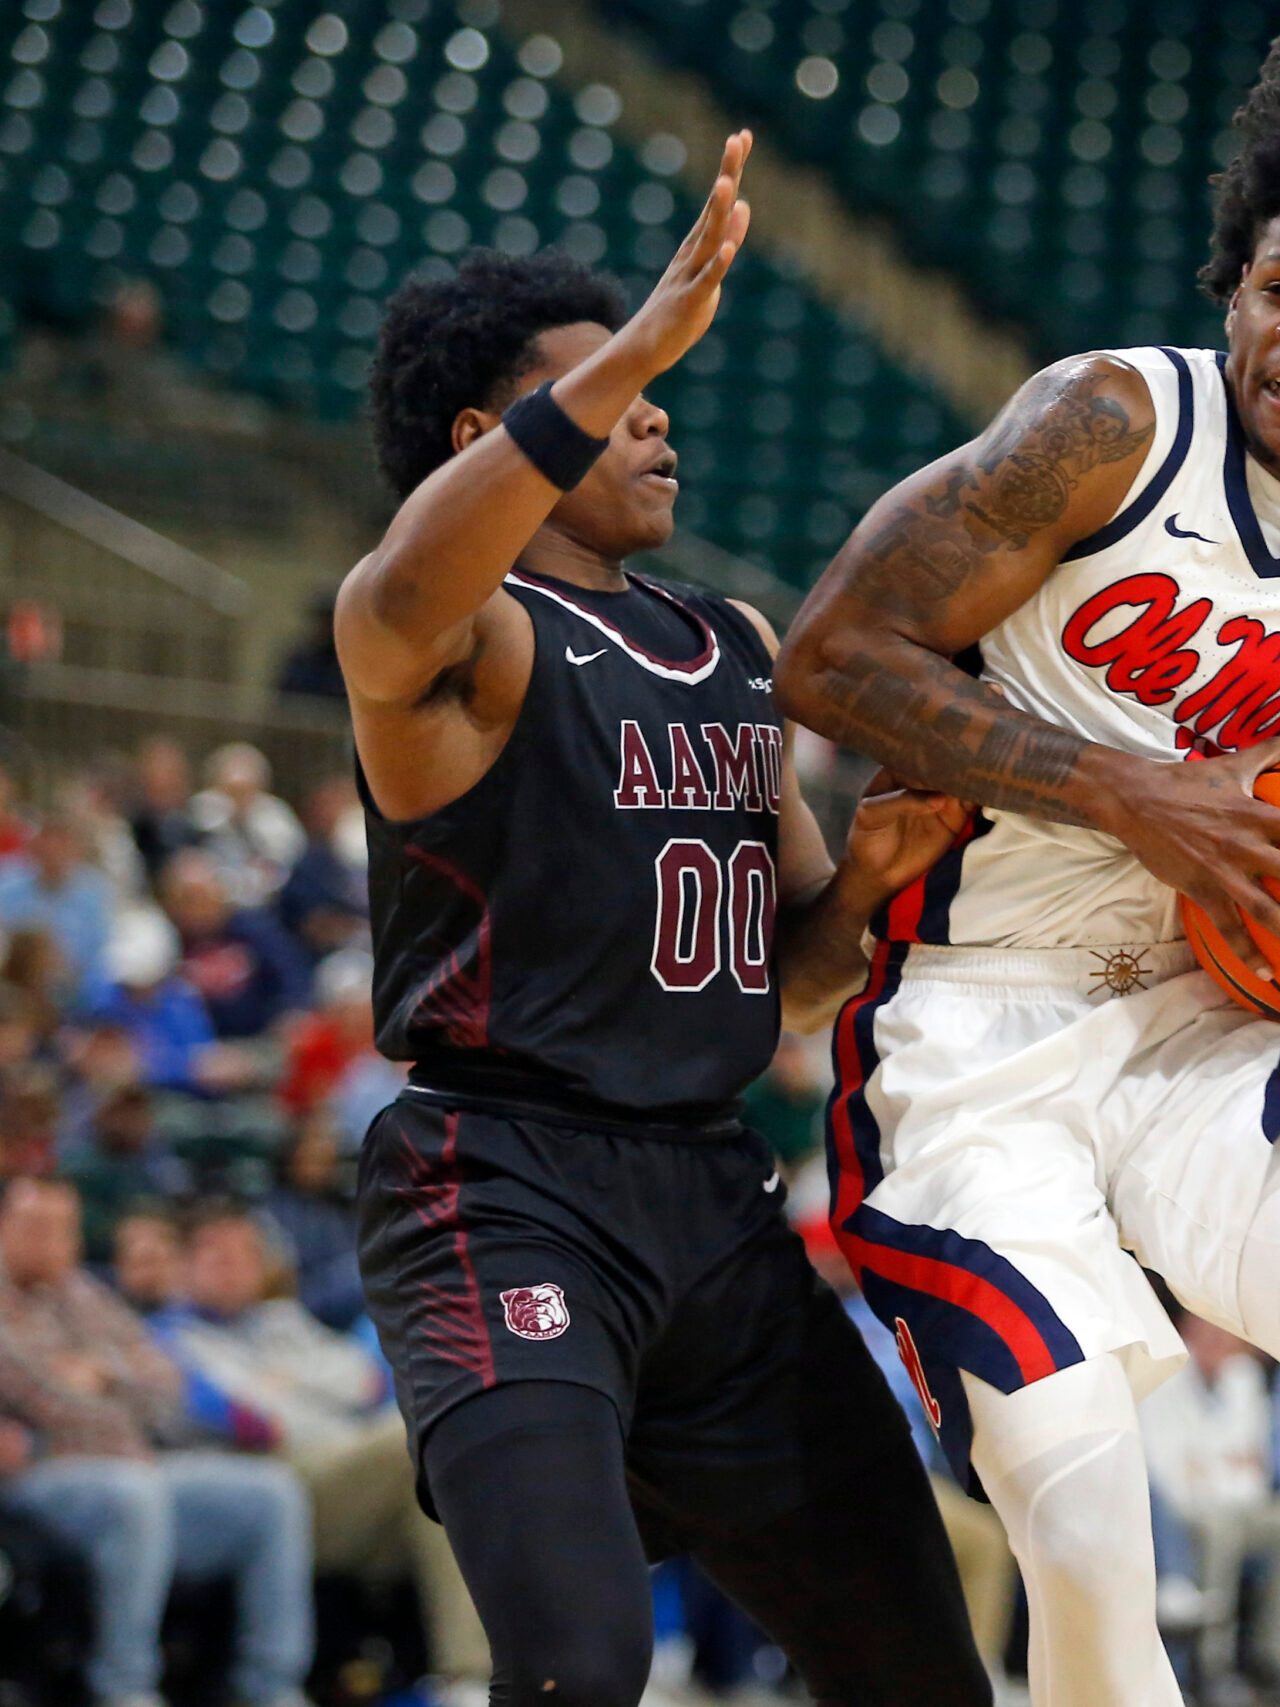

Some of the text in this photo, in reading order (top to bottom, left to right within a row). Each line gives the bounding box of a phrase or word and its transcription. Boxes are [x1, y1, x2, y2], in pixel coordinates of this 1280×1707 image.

[1061, 572, 1213, 706] Ole
[613, 719, 784, 815] AAMU
[650, 838, 778, 995] 00
